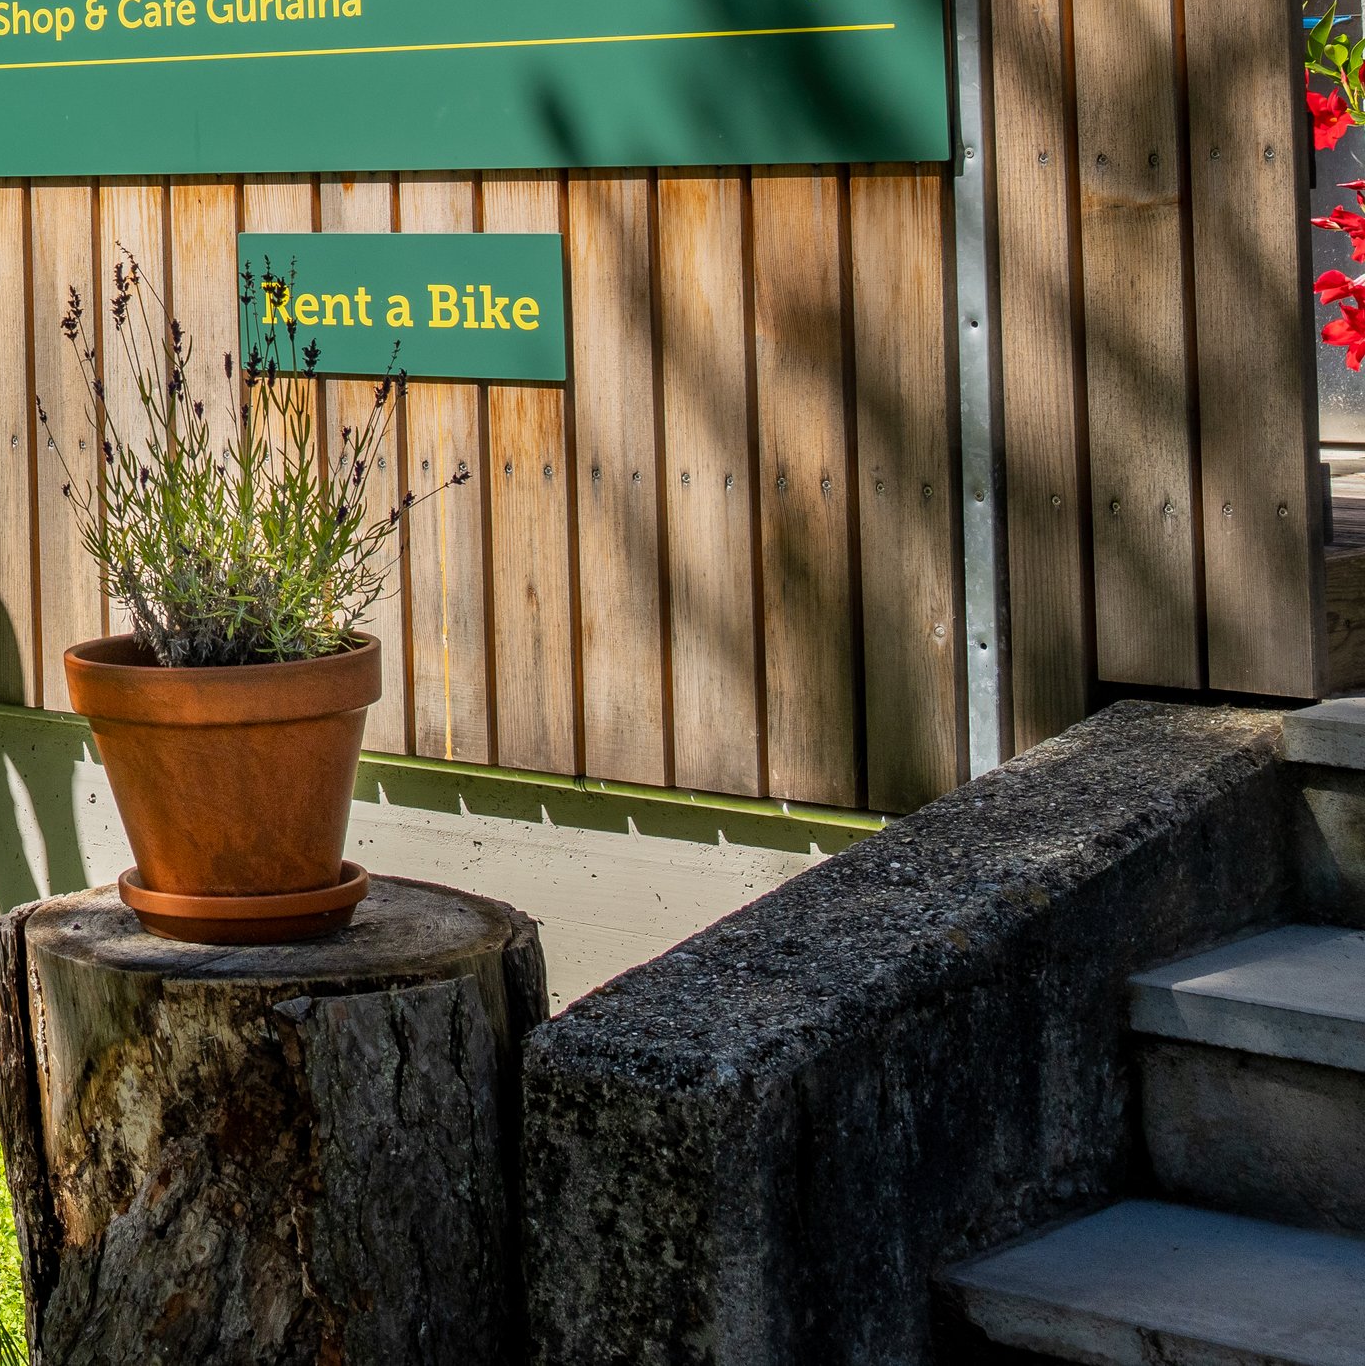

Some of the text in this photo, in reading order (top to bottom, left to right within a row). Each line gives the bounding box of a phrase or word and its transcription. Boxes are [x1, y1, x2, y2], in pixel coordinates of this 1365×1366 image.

[261, 281, 540, 331] Rent a Bike
